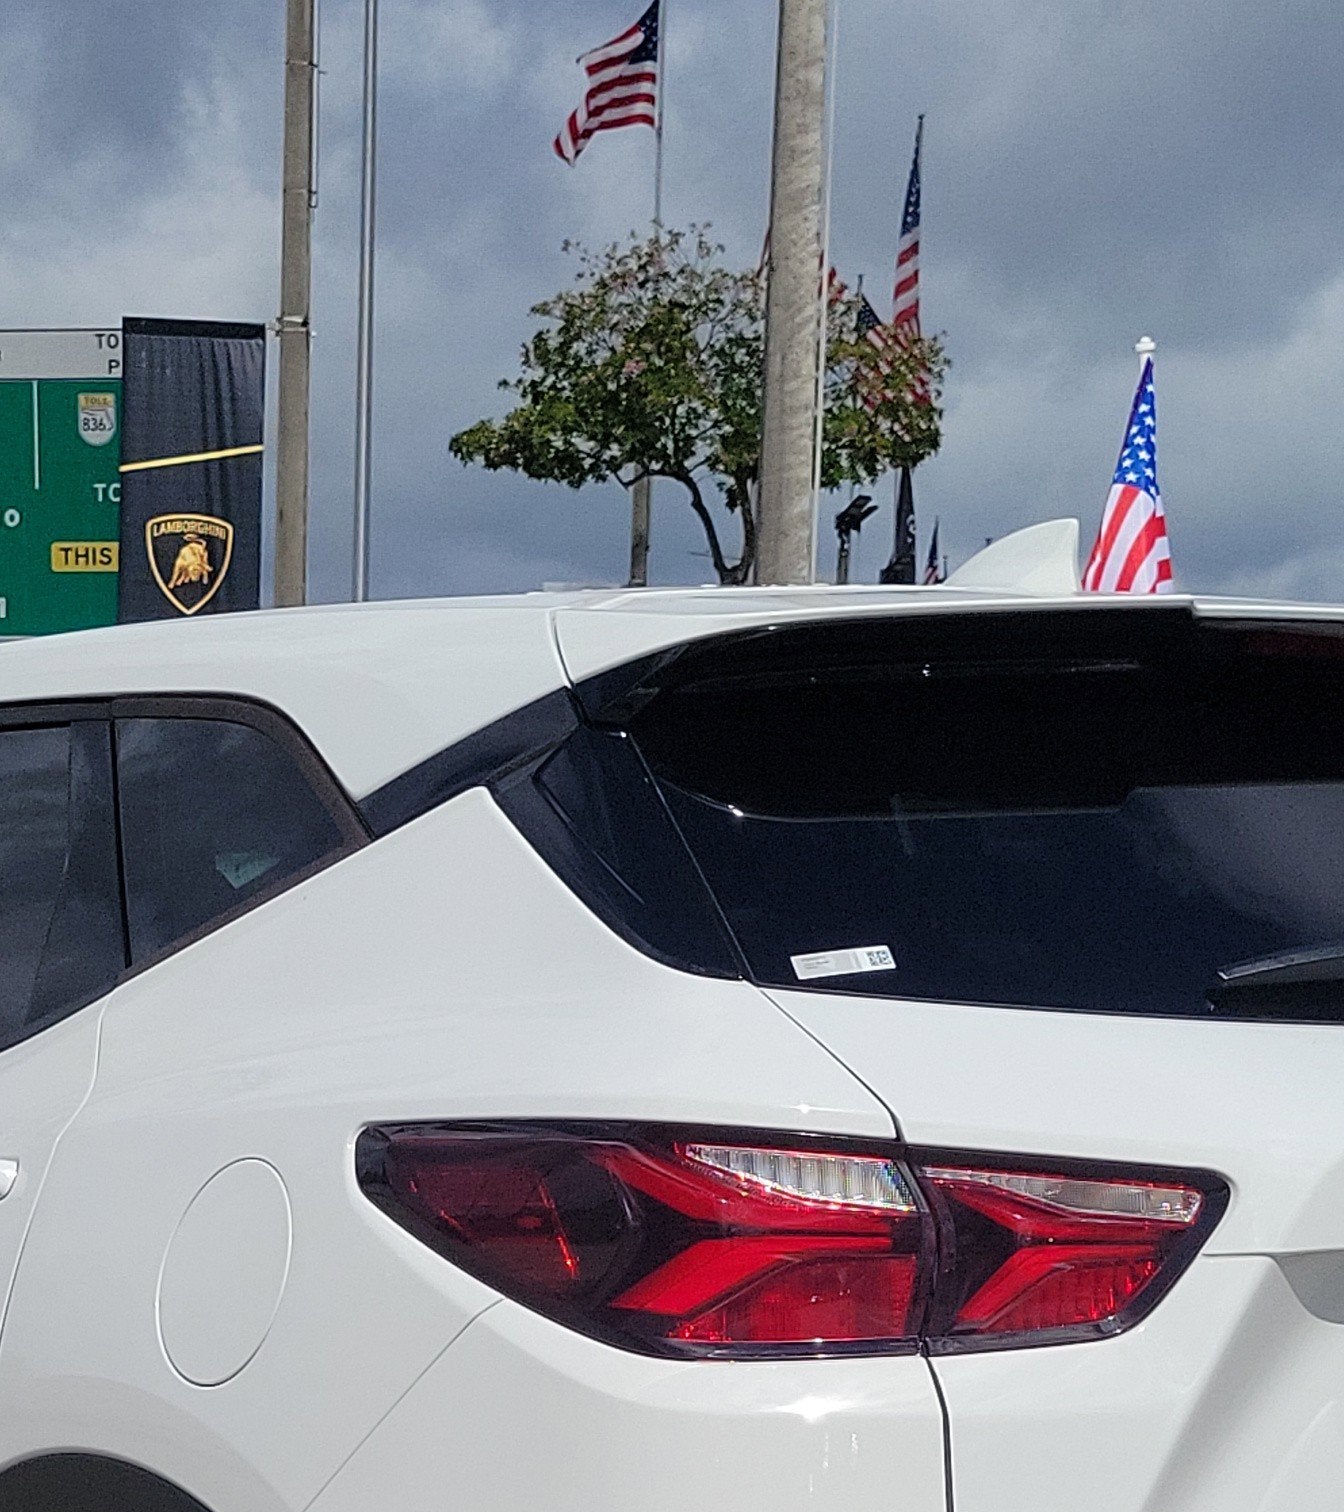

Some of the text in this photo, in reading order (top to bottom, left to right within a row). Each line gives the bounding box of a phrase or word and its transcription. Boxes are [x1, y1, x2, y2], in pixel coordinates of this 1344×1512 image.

[82, 417, 107, 432] 836
[153, 520, 226, 540] LAMBORGHINI
[59, 547, 112, 566] THIS
